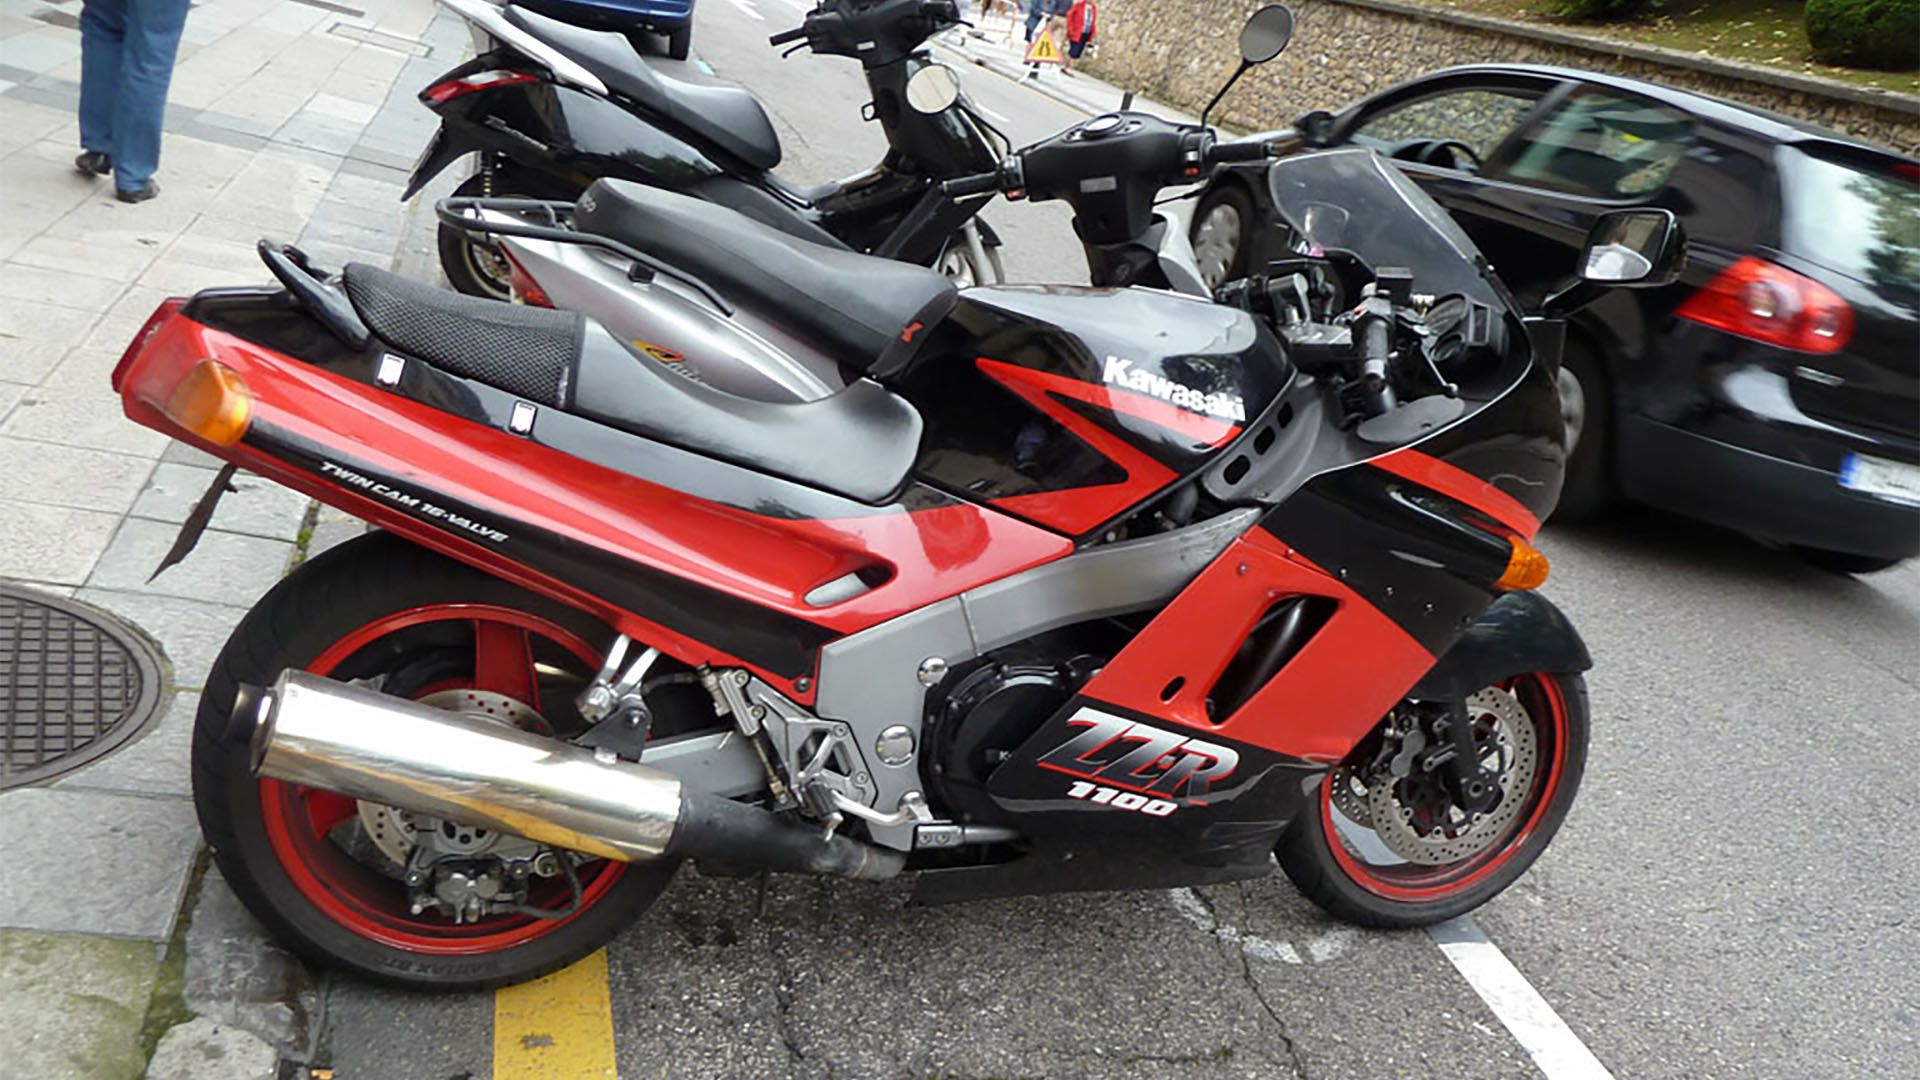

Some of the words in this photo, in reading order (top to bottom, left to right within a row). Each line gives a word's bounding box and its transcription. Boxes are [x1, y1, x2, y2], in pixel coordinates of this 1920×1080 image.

[1103, 355, 1246, 421] Kawasaki
[321, 461, 376, 488] TWIN
[371, 483, 420, 507] CAM
[1066, 780, 1179, 817] 1100
